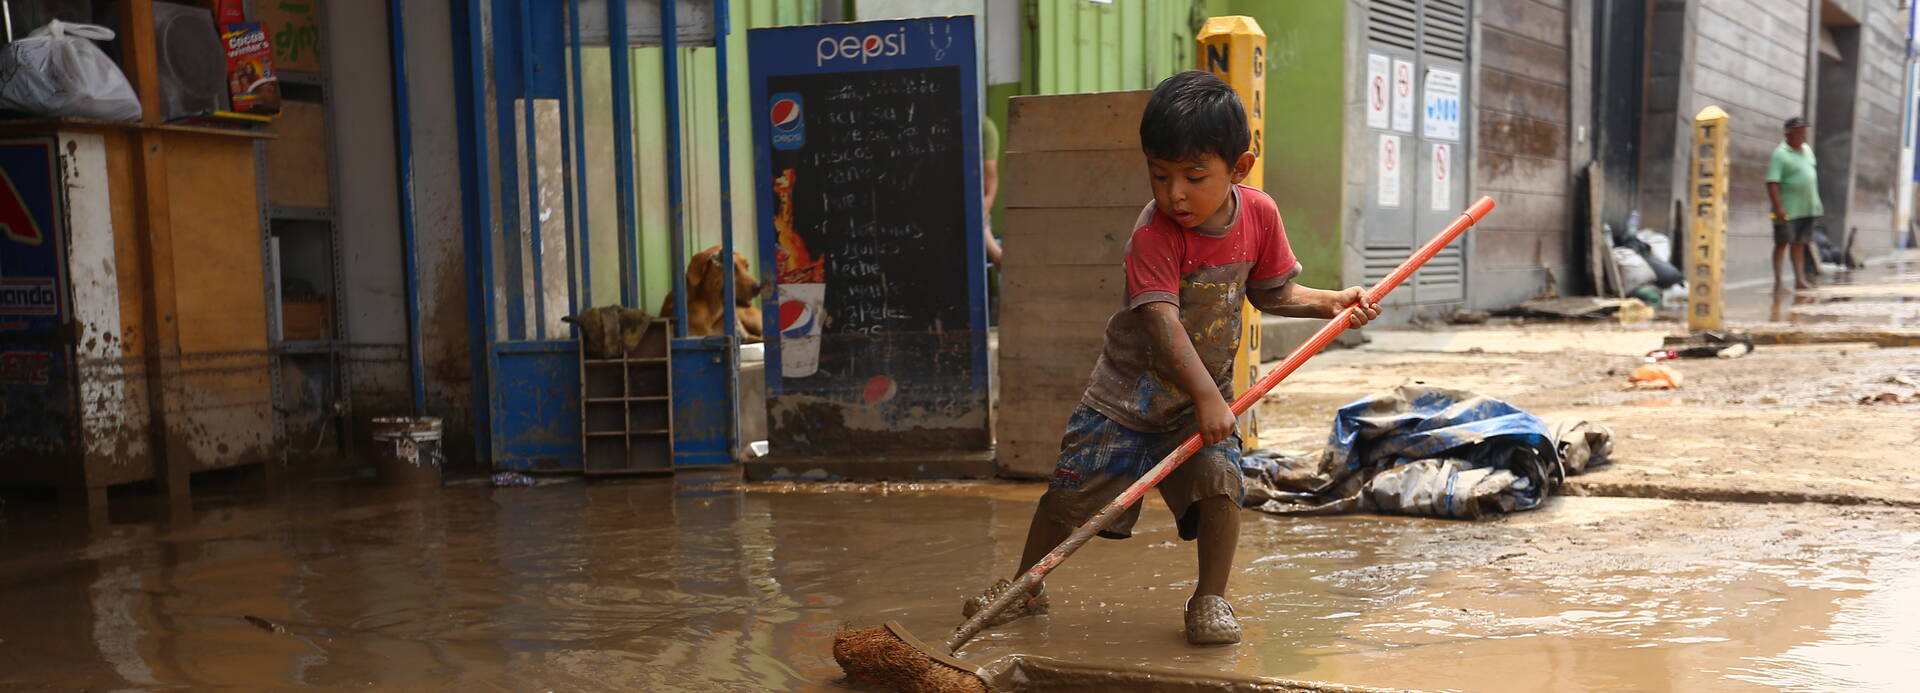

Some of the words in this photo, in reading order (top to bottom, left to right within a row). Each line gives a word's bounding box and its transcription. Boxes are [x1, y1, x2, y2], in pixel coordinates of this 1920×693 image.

[228, 31, 265, 49] Cocoa
[816, 27, 907, 66] pepsi
[1253, 46, 1263, 158] GAS
[773, 134, 801, 143] pepsi
